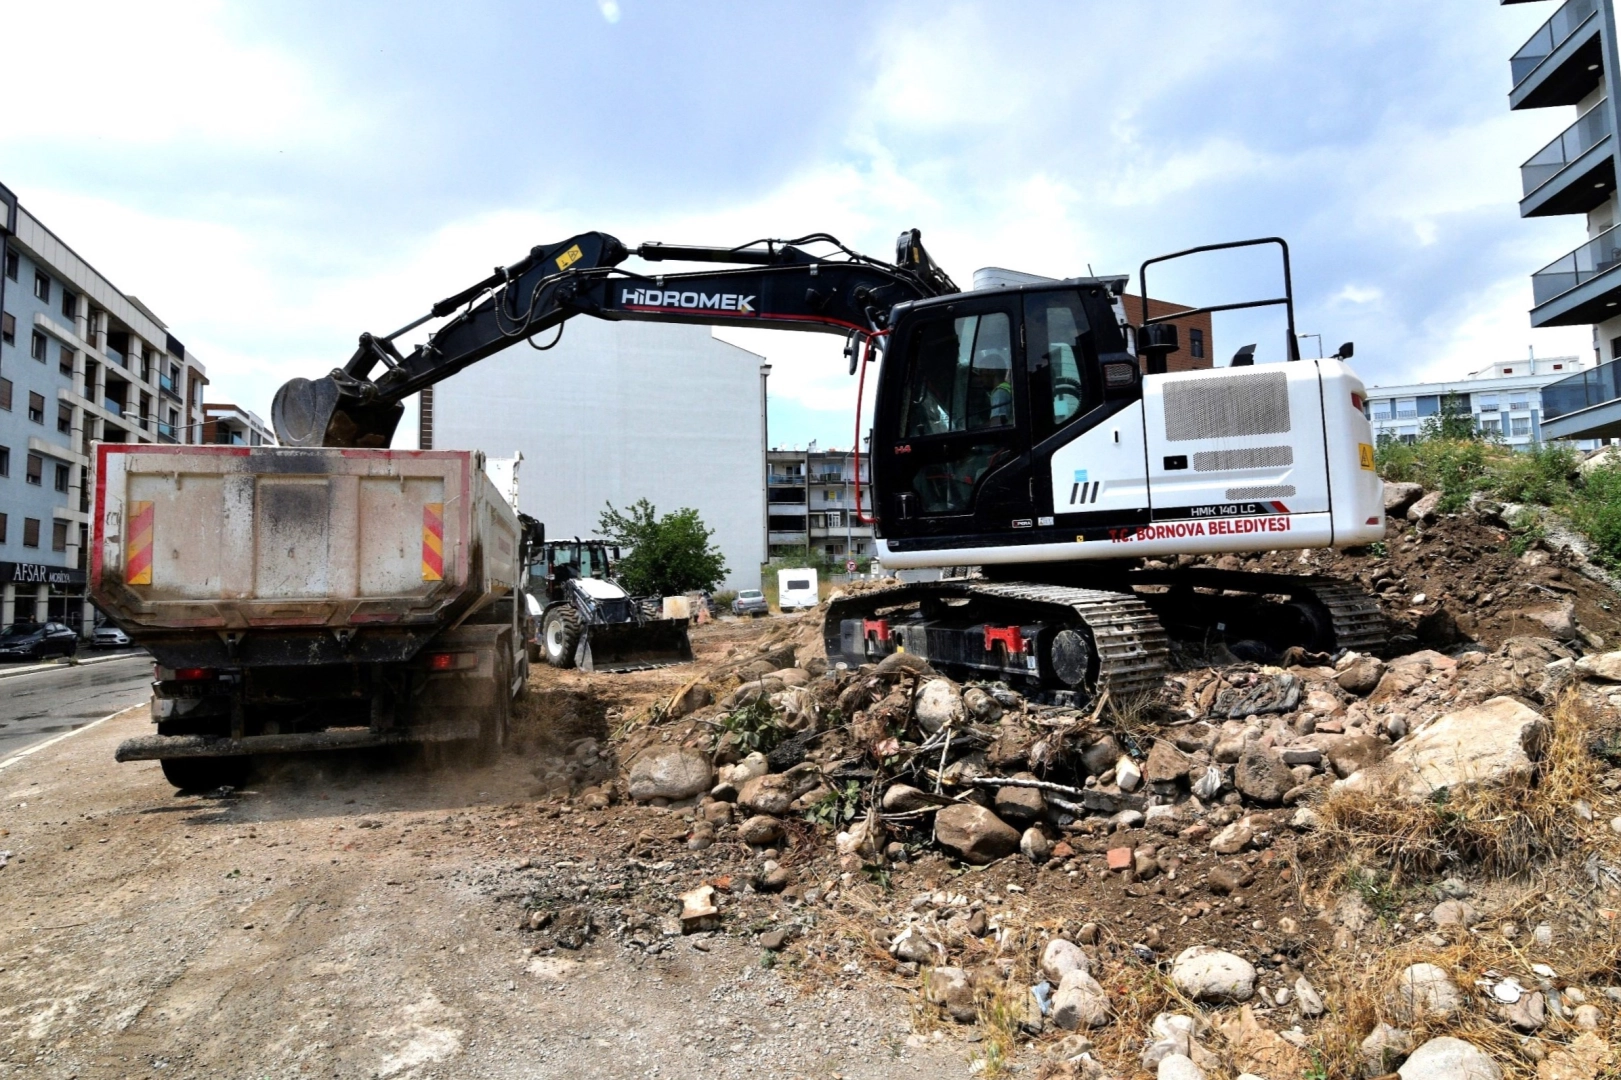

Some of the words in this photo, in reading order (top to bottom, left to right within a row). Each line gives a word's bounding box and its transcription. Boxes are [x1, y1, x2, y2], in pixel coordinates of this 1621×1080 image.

[1191, 506, 1216, 516] HMK
[1219, 505, 1237, 514] 140
[1240, 504, 1256, 513] LC
[1109, 528, 1133, 543] T.C.
[1136, 522, 1205, 541] BORNOVA
